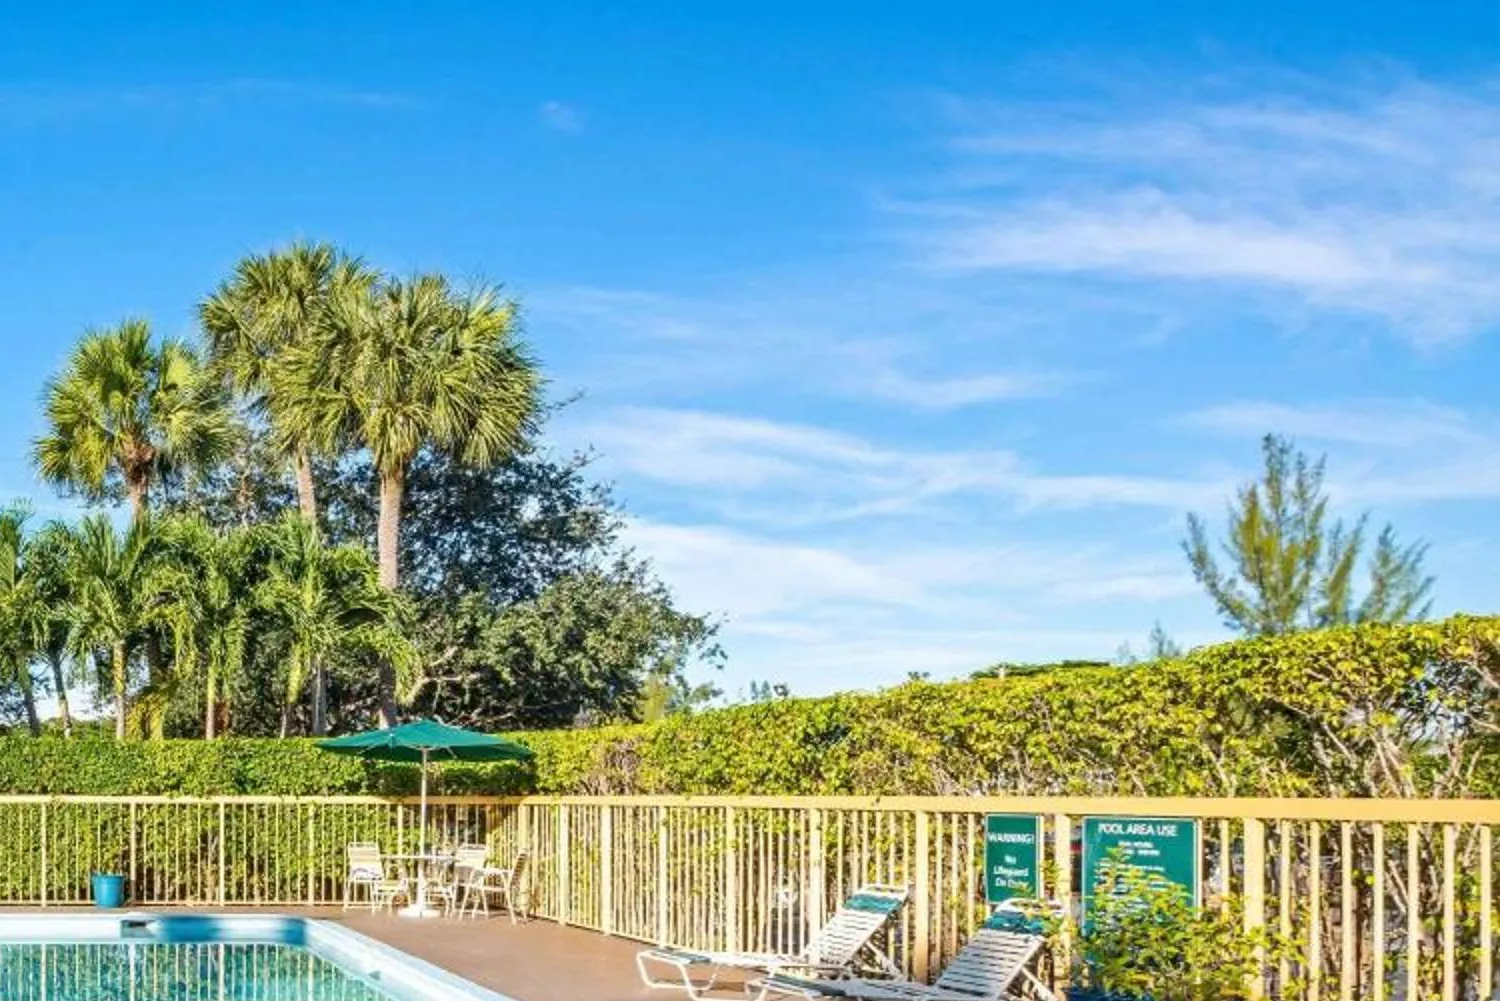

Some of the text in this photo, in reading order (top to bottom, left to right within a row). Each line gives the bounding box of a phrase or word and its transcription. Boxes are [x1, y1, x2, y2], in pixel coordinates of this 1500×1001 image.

[1098, 823, 1178, 837] POOL AREA USE
